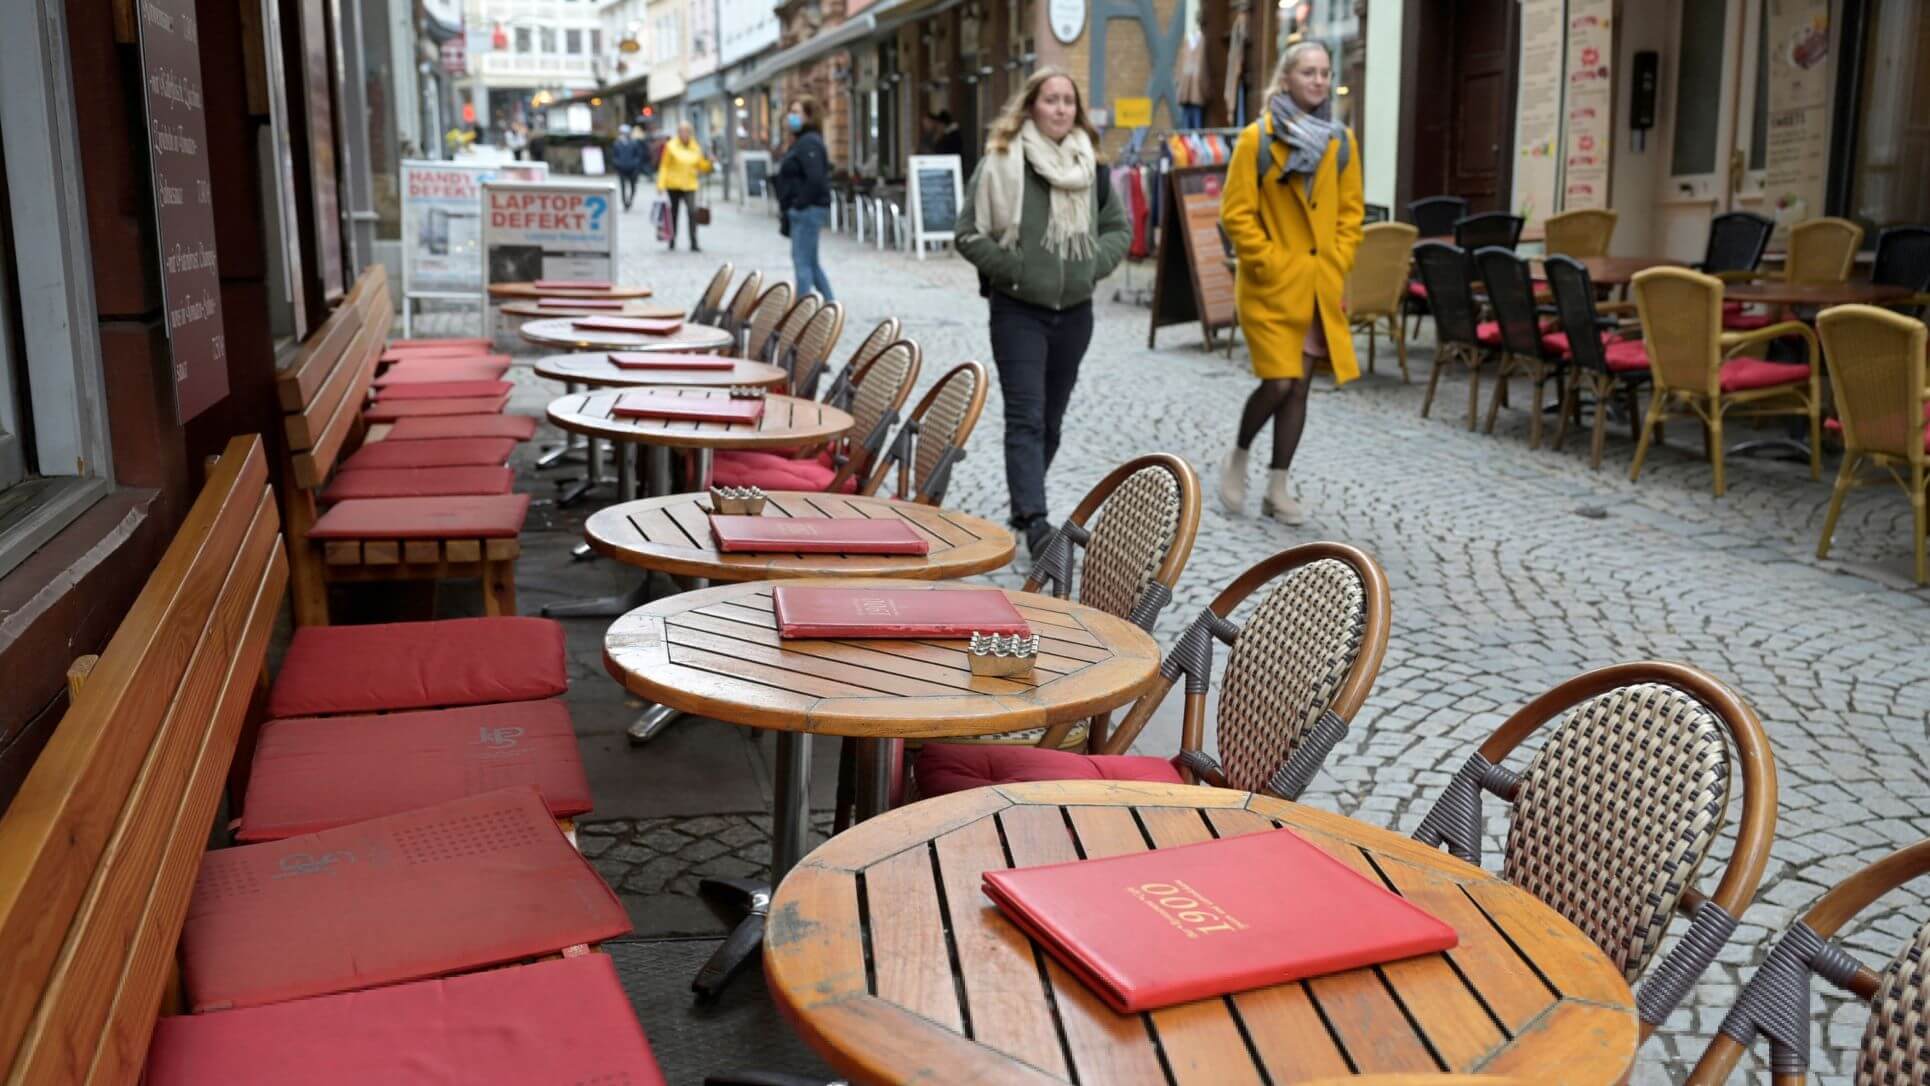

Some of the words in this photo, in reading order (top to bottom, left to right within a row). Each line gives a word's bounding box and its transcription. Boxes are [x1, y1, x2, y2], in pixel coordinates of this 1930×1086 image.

[409, 183, 476, 197] DEFEKT
[491, 194, 583, 211] LAPTOP
[491, 211, 586, 230] DEFEKT
[1141, 883, 1236, 934] 1900
